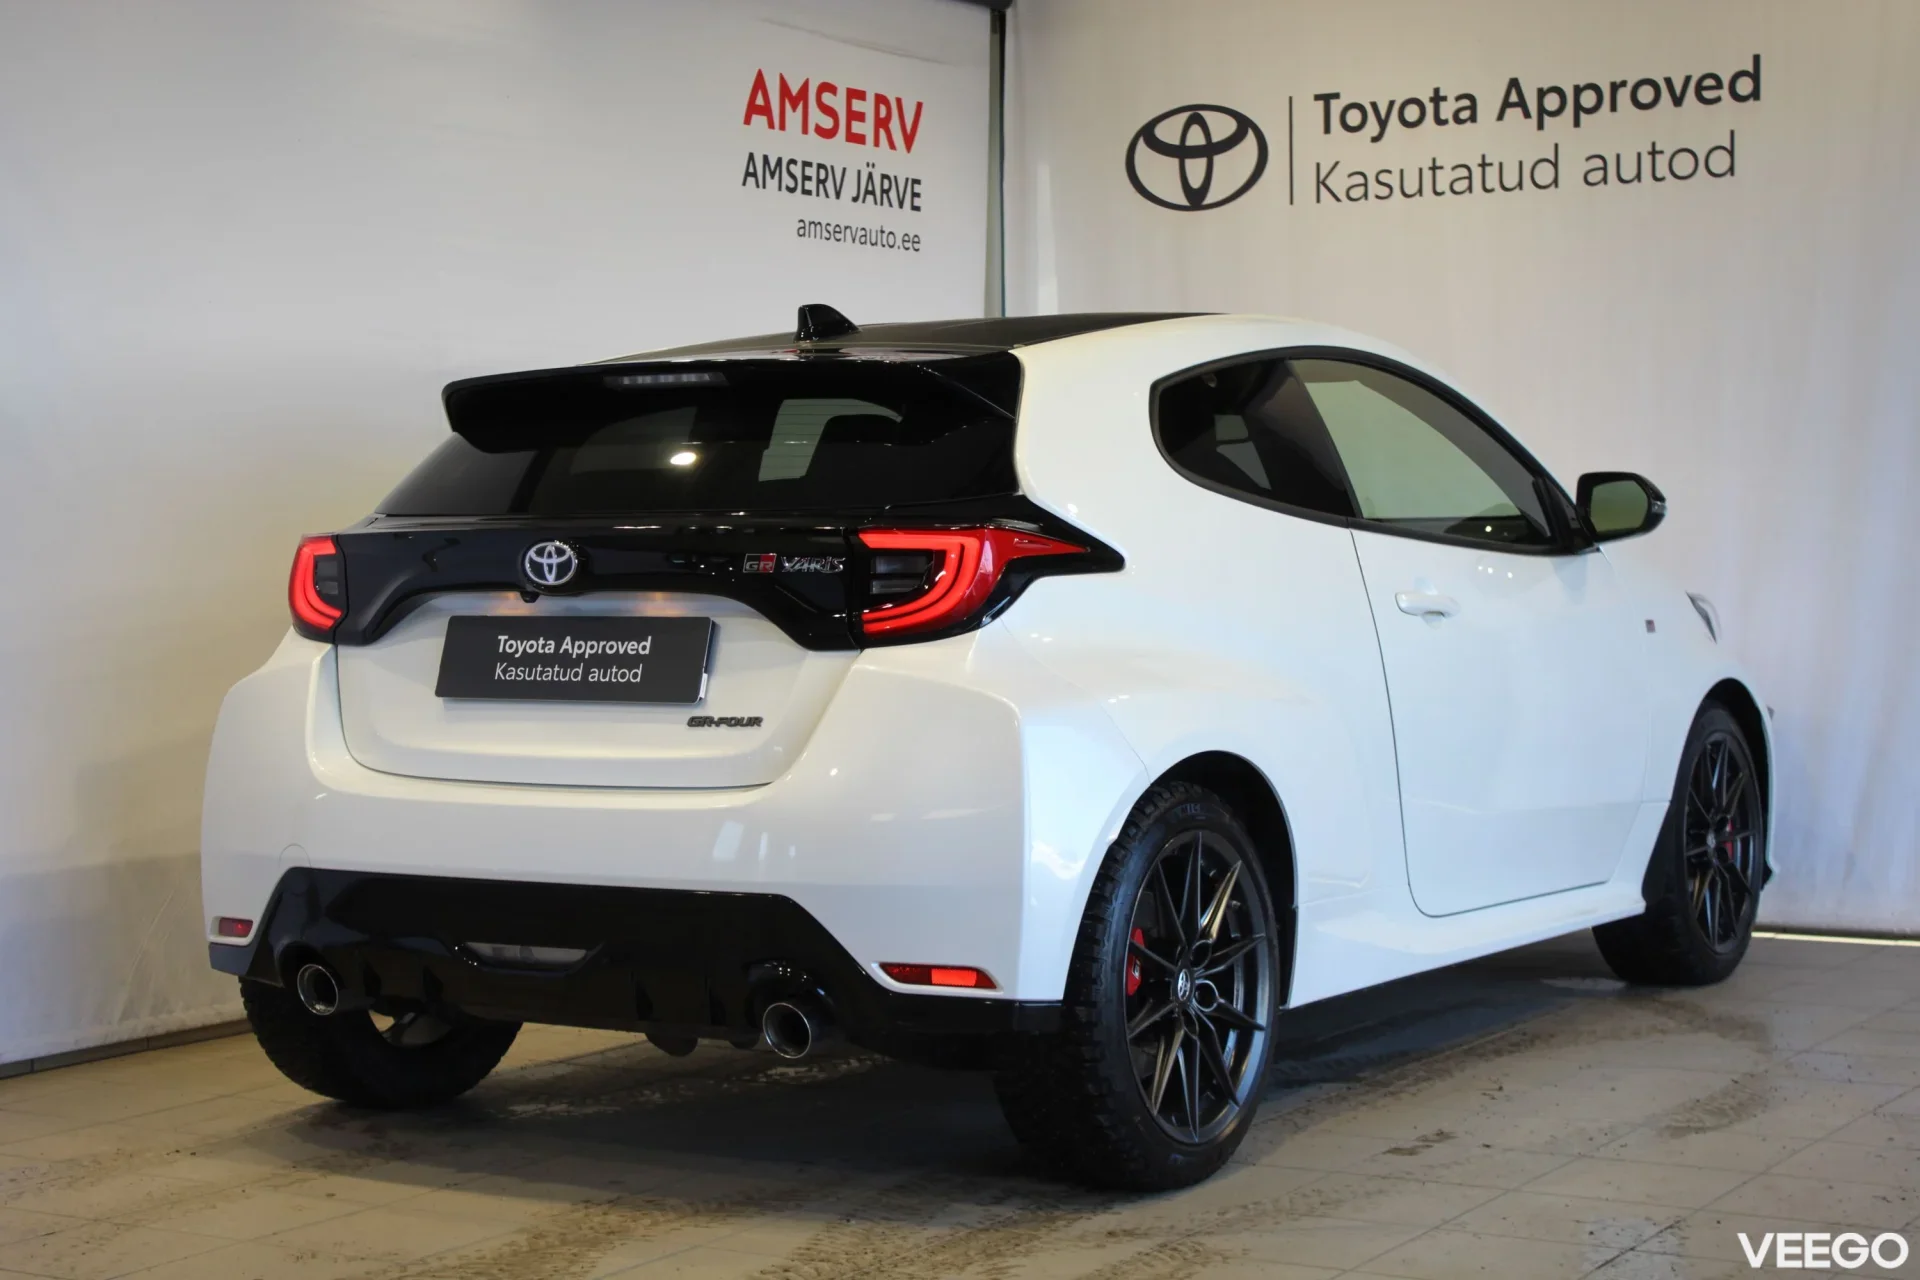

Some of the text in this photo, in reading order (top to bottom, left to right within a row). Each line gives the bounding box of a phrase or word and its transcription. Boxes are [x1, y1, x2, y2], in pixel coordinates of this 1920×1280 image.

[743, 68, 923, 154] AMSERV
[1313, 54, 1761, 143] Toyota Approved
[741, 152, 922, 212] AMSERV JÄRVE
[1315, 129, 1735, 204] Kasutatud autod
[796, 218, 921, 252] amservauto.ee
[745, 561, 773, 571] GR
[498, 635, 652, 659] Toyota Approved
[494, 662, 643, 682] Kasutatud autod
[687, 715, 764, 728] GR-FOUR
